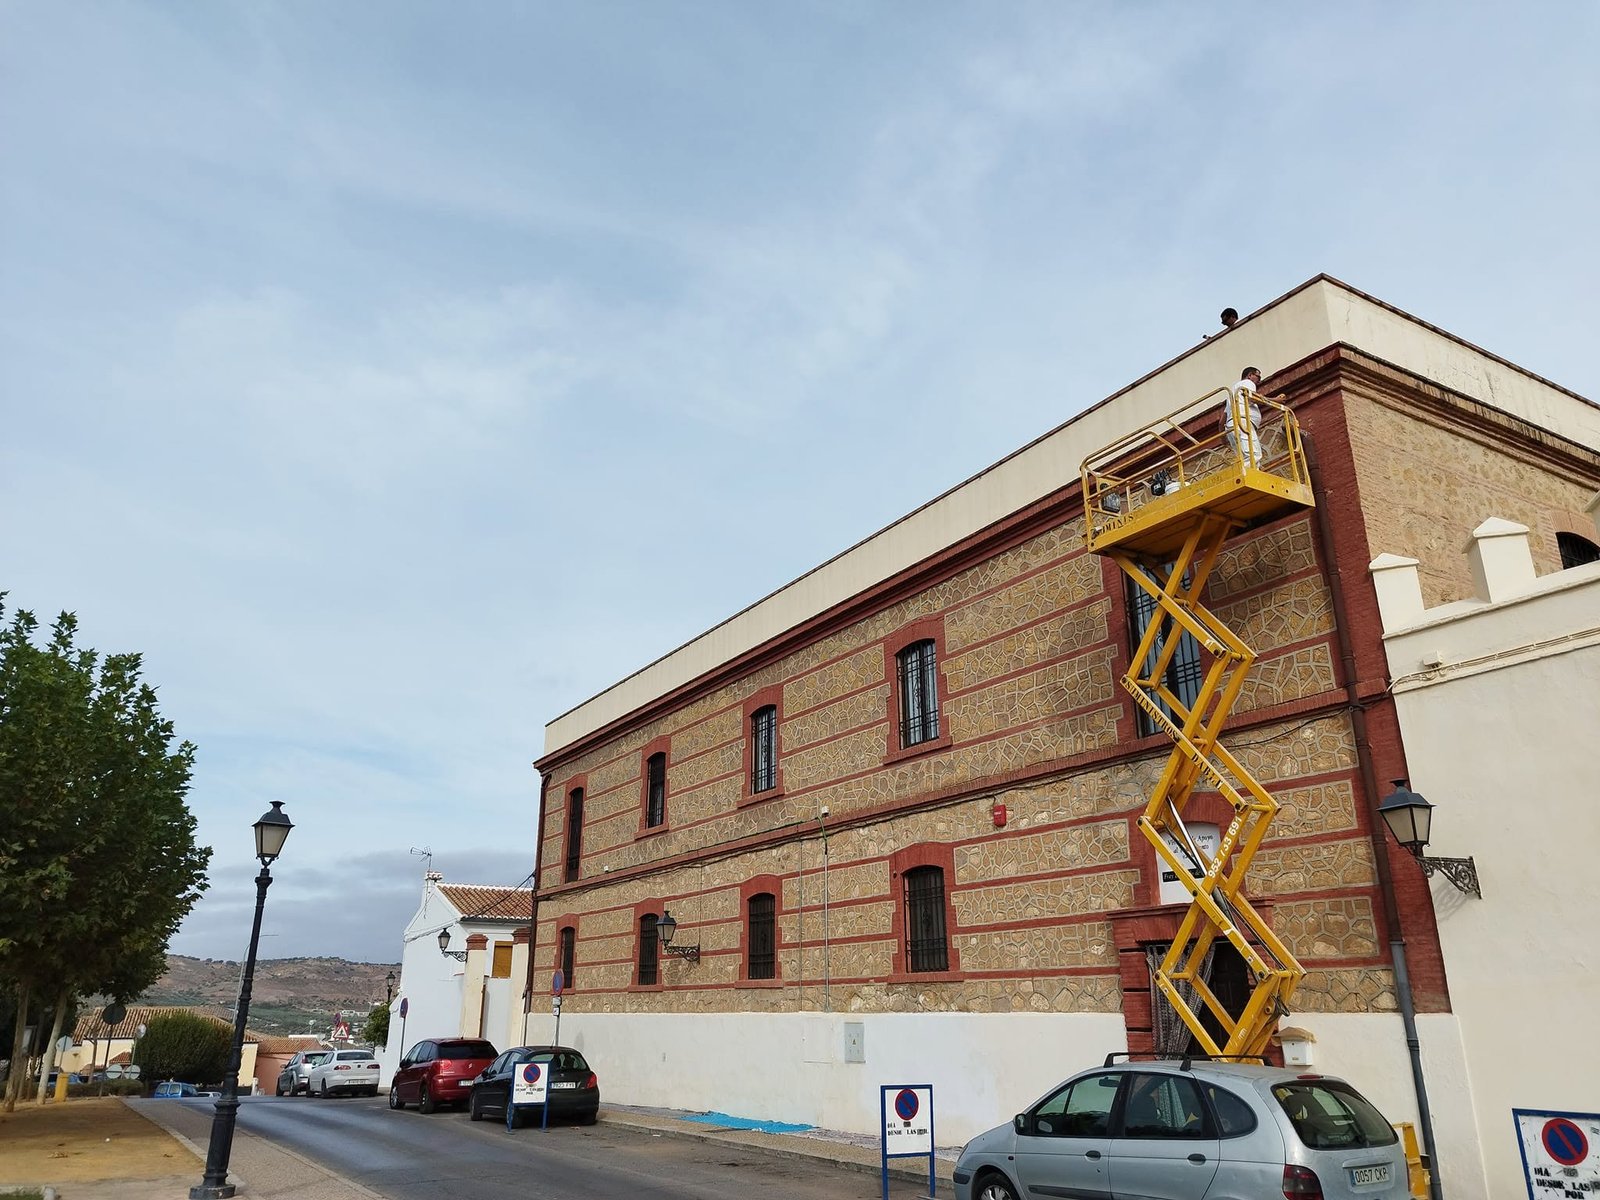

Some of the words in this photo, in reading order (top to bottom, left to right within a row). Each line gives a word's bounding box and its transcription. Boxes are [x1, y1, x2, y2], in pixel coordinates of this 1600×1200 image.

[1208, 858, 1222, 878] 952
[1228, 816, 1242, 836] 691
[1355, 1169, 1373, 1183] 0057
[1571, 1182, 1590, 1191] LAS
[1565, 1190, 1585, 1200] POR
